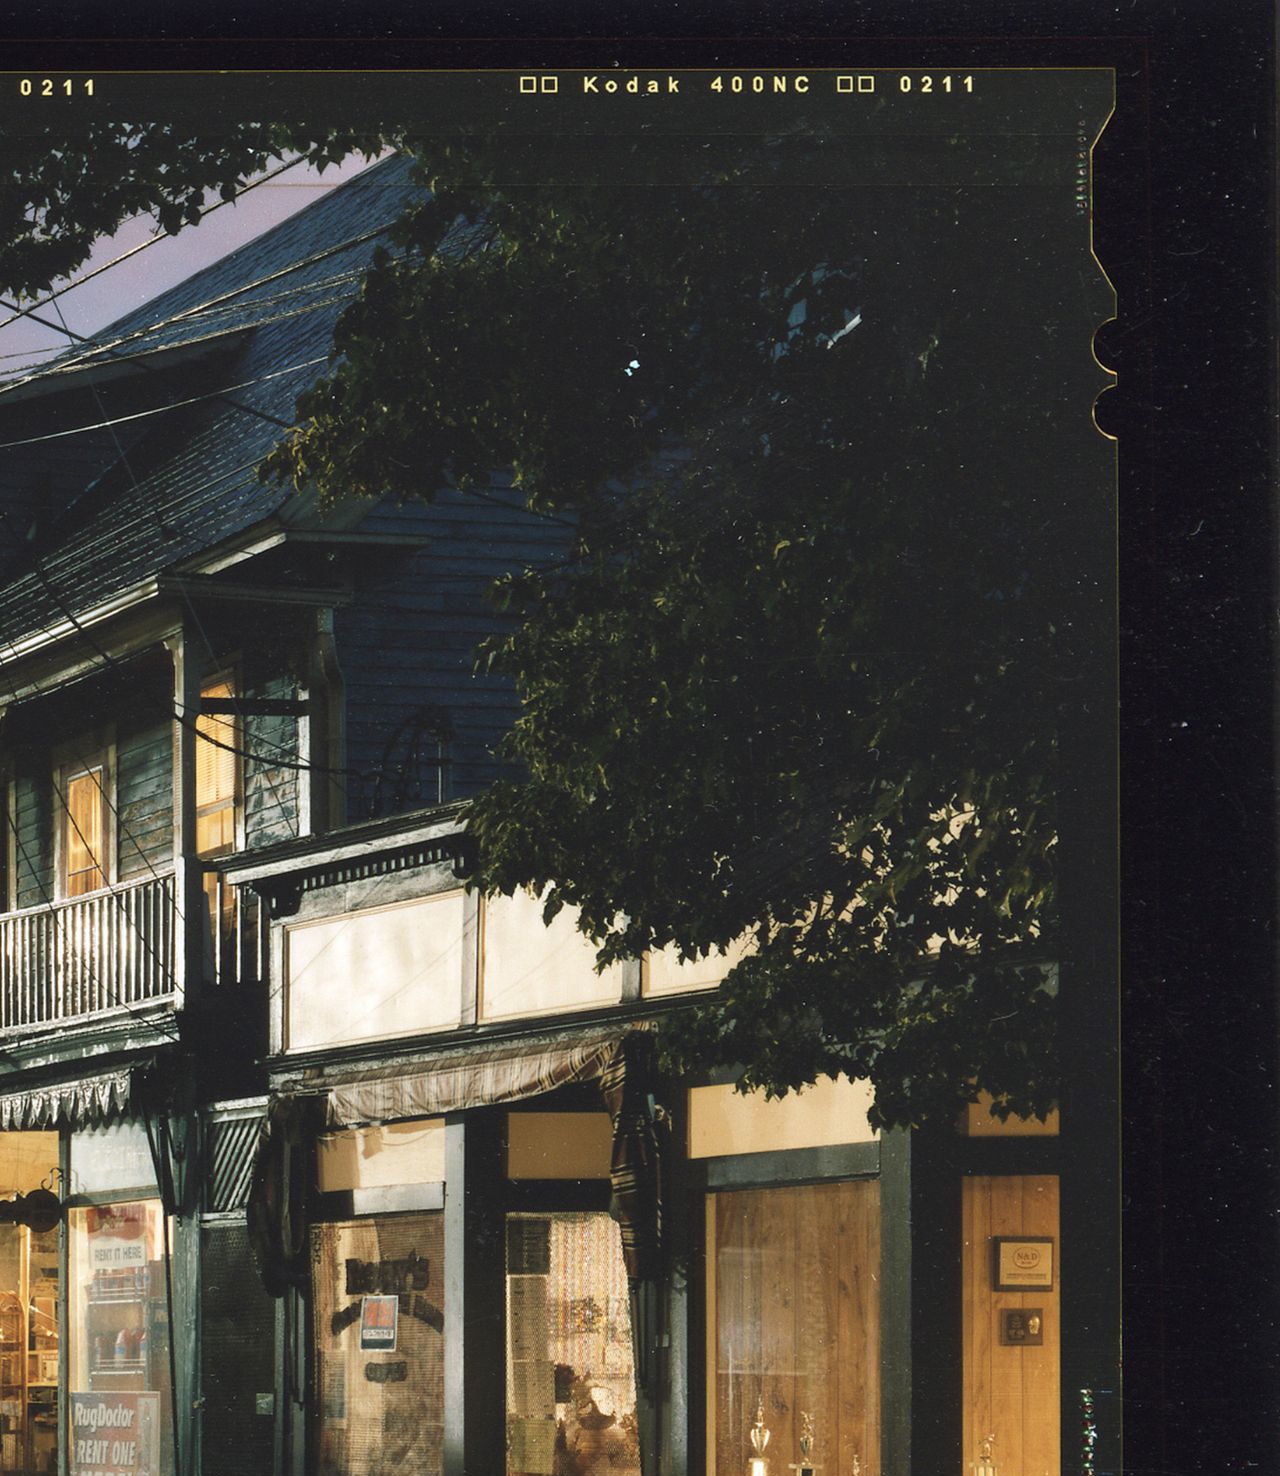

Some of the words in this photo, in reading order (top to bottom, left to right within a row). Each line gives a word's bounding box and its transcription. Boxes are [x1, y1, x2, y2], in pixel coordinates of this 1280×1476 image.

[20, 80, 94, 96] 0211
[583, 77, 679, 93] Kodak
[711, 77, 809, 93] 400NC
[901, 77, 975, 93] 0211
[94, 1248, 113, 1262] RENT
[123, 1246, 142, 1260] HERE
[76, 1439, 109, 1464] RENT
[111, 1441, 137, 1466] ONE
